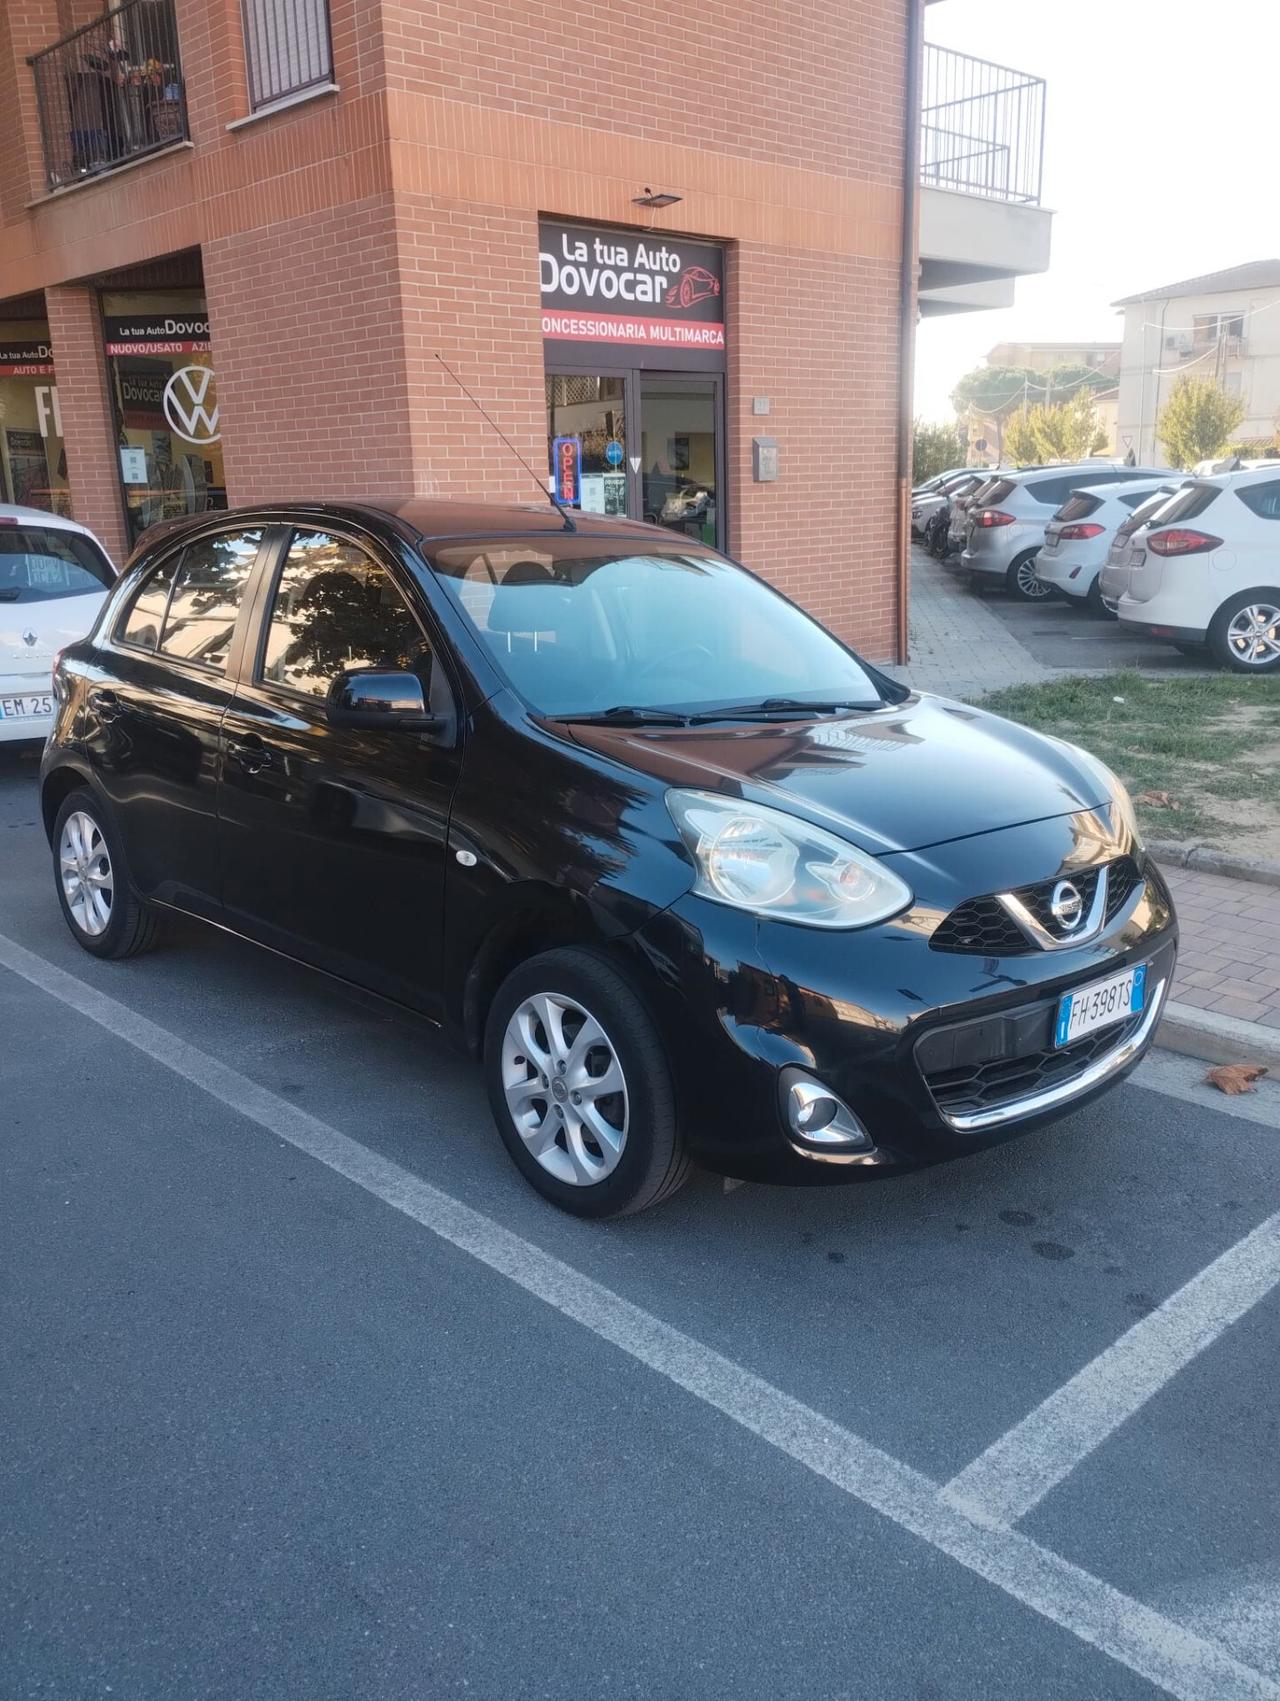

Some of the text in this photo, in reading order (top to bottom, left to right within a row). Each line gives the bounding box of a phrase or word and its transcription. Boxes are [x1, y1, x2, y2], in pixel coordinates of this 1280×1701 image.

[562, 233, 681, 273] La tua Auto
[539, 252, 668, 303] Dovocar
[120, 327, 130, 336] La
[131, 327, 145, 335] tua
[146, 326, 165, 335] Auto
[650, 325, 725, 345] MULTIMARCA
[9, 351, 20, 359] tua
[22, 350, 38, 359] Auto
[110, 343, 183, 354] NUOVO/USATO
[13, 365, 37, 375] AUTO
[40, 365, 46, 374] E
[562, 443, 574, 500] OPEN
[2, 697, 52, 716] EM 25
